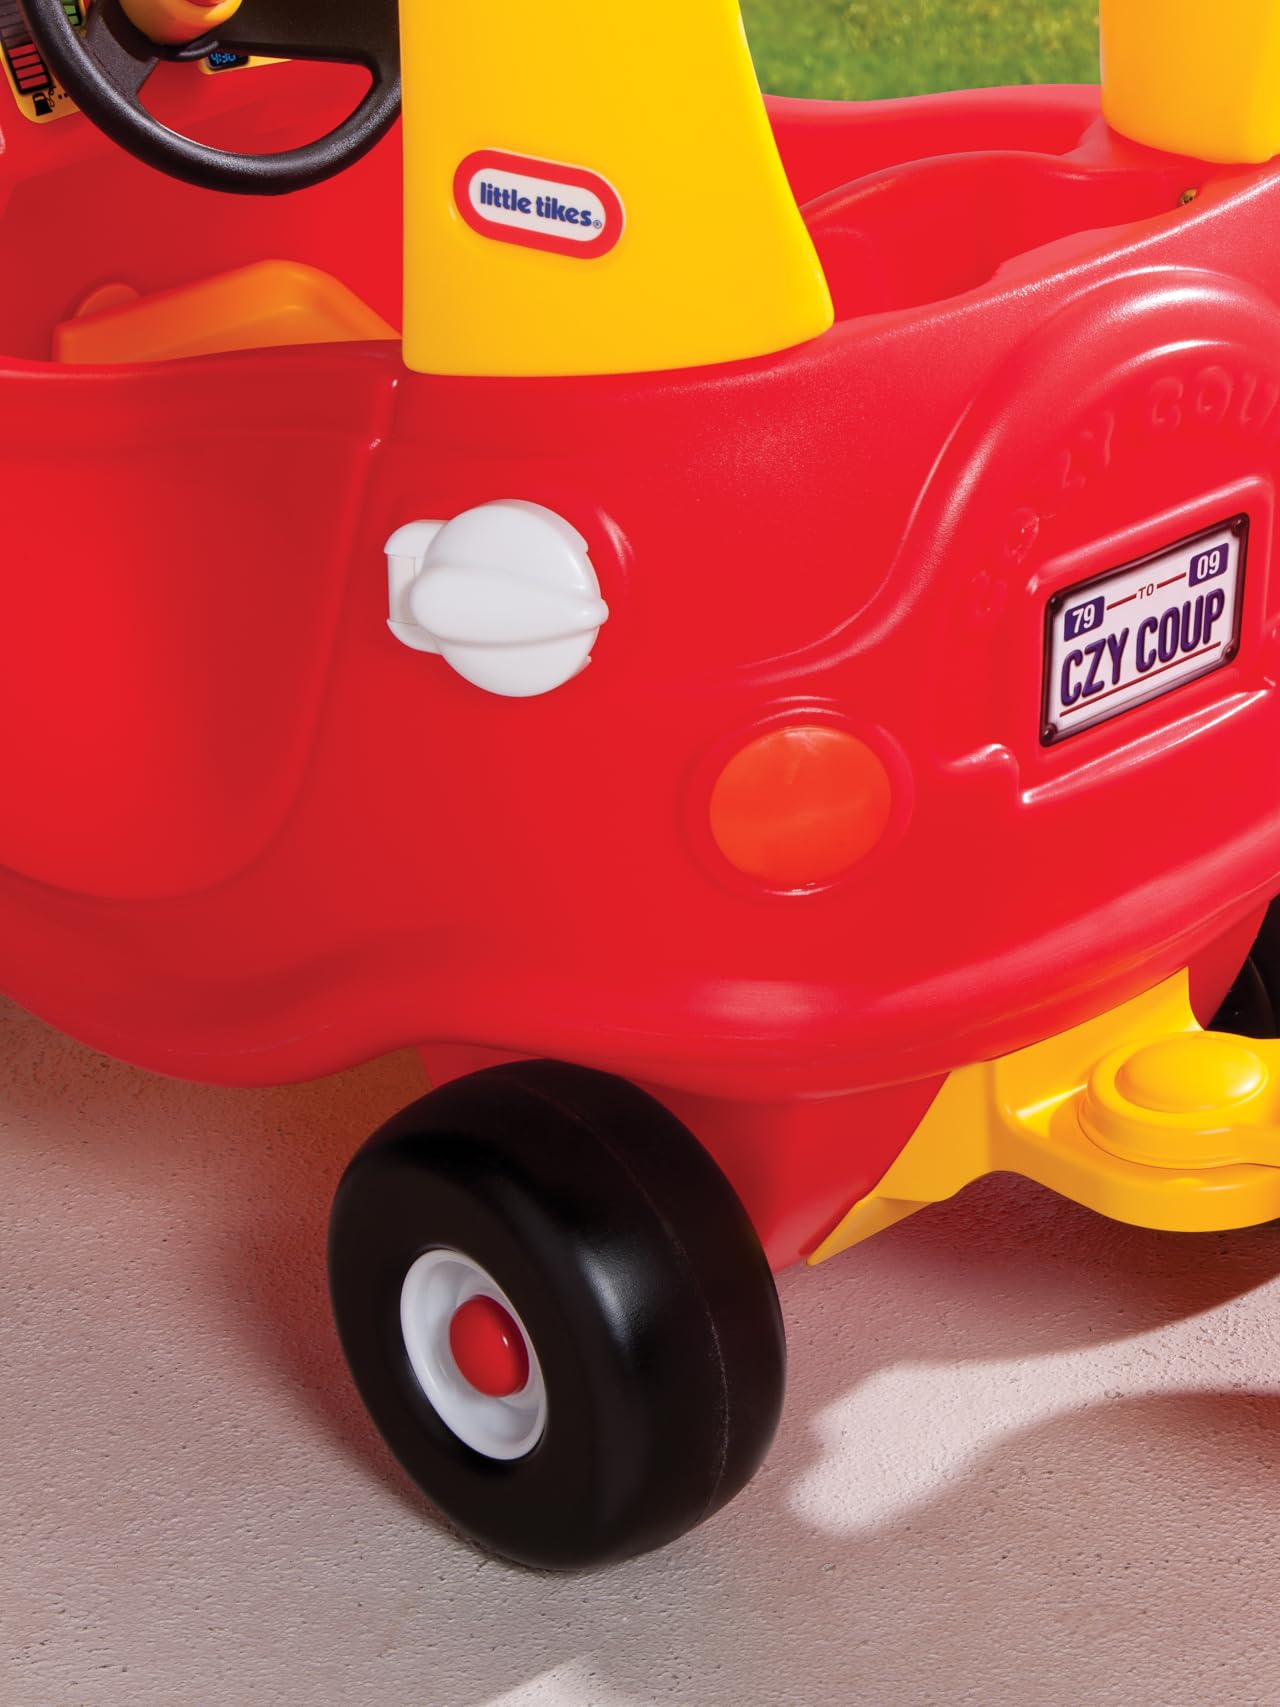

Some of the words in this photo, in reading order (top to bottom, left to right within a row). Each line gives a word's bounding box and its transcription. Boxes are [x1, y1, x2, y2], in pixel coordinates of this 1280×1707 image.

[480, 181, 532, 214] little
[1072, 604, 1096, 634] 79
[1138, 583, 1154, 599] TO
[1196, 550, 1220, 580] 09
[1060, 627, 1130, 706] CZY
[1136, 588, 1225, 673] COUP
